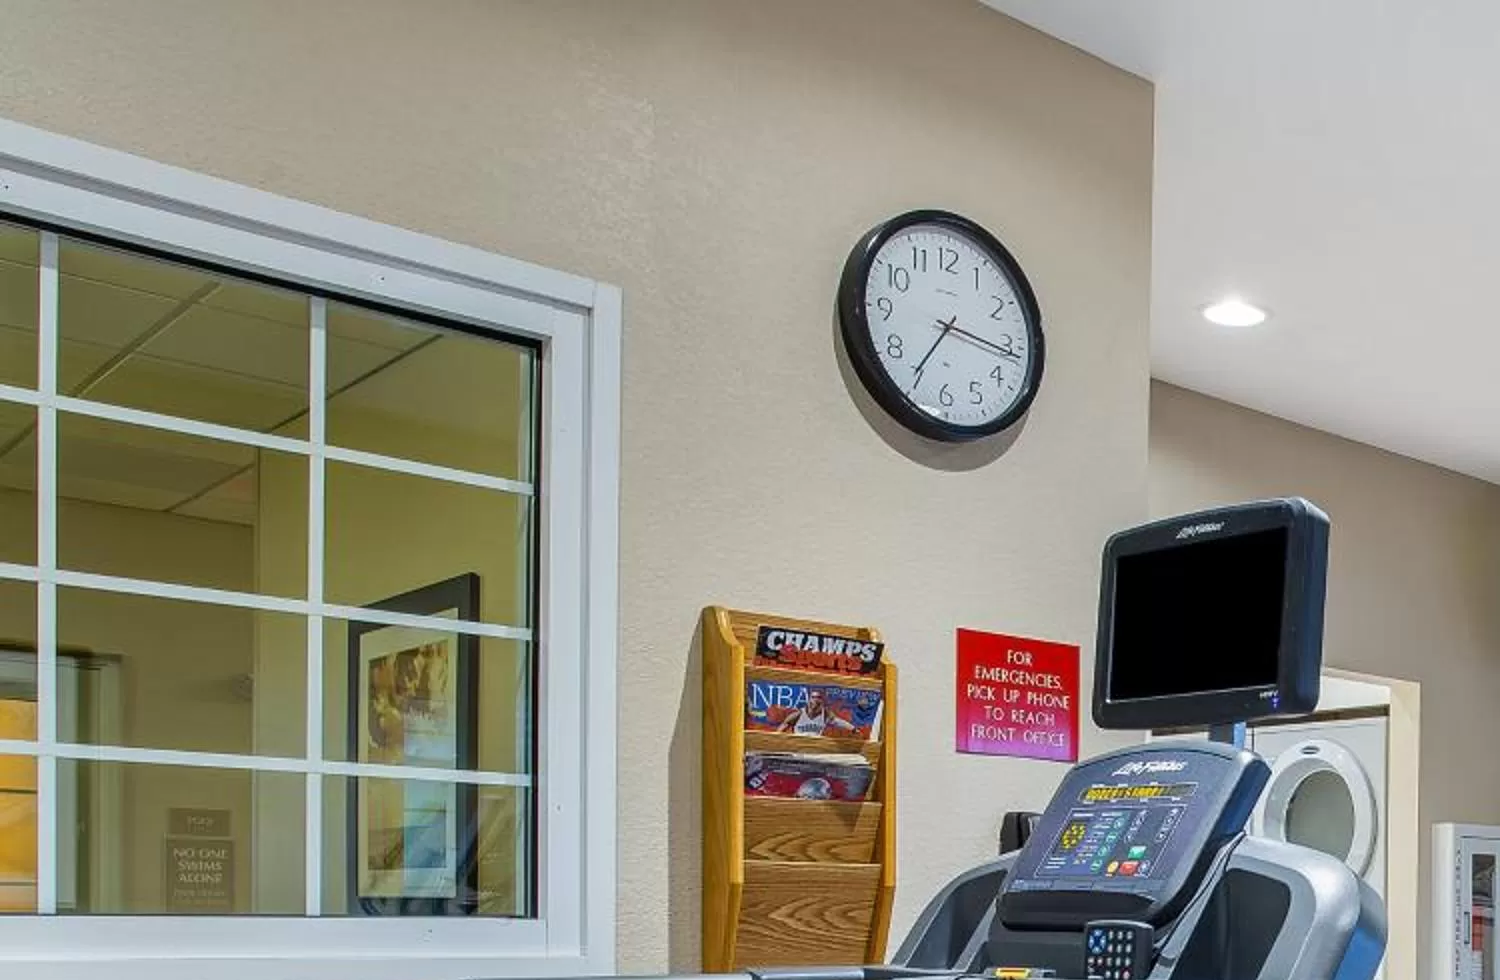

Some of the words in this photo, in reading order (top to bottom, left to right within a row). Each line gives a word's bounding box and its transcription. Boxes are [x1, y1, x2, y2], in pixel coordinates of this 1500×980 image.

[913, 246, 927, 273] 11
[938, 247, 959, 275] 12
[887, 264, 910, 292] 10
[973, 267, 980, 290] 1
[877, 297, 893, 321] 9
[990, 295, 1004, 320] 2
[887, 333, 903, 359] 8
[1001, 333, 1014, 356] 3
[989, 365, 1004, 388] 4
[939, 383, 954, 407] 6
[969, 381, 983, 405] 5
[766, 630, 878, 663] CHAMPS
[1006, 649, 1033, 666] FOR
[752, 683, 809, 710] NBA
[967, 683, 996, 701] PICK
[1003, 688, 1020, 703] UP
[1027, 691, 1070, 711] PHONE
[984, 705, 1005, 721] TO
[1011, 709, 1055, 726] REACH
[971, 723, 1017, 742] FRONT
[1023, 729, 1065, 747] OFFICE
[173, 847, 196, 860] NO
[199, 848, 229, 860] ONE
[178, 860, 223, 872] SWIMS
